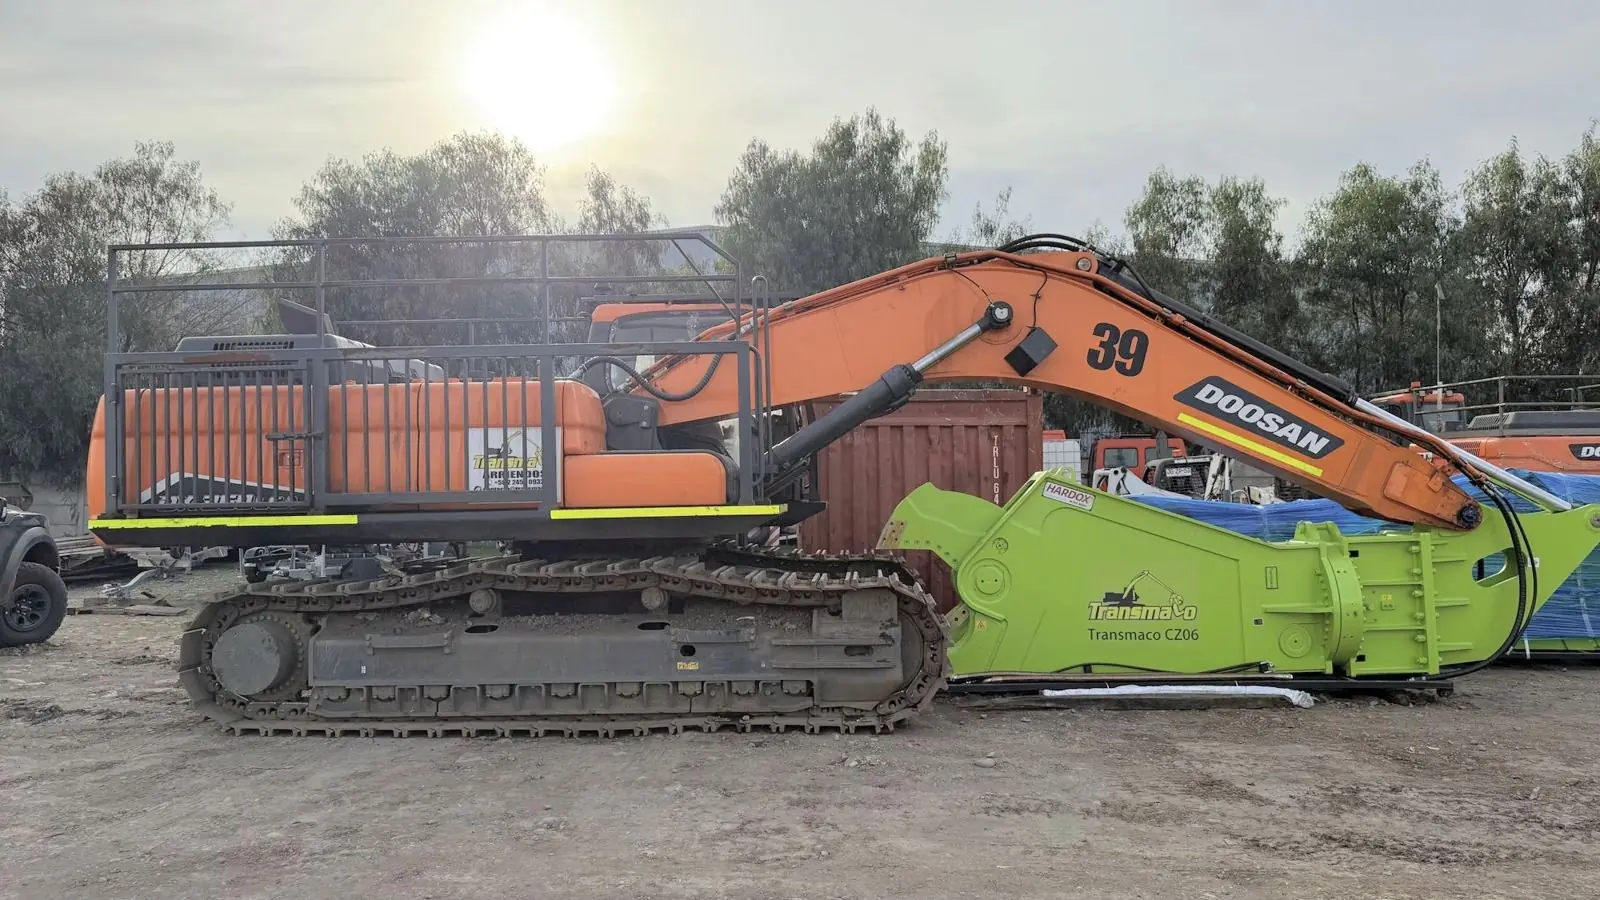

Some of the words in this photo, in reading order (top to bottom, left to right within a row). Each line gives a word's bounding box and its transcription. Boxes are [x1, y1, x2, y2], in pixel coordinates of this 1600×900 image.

[1086, 322, 1149, 377] 39
[1194, 383, 1330, 455] DOOSAN
[1046, 483, 1091, 504] HARDOX
[1088, 628, 1161, 641] Transmaco
[1165, 628, 1200, 641] CZ06
